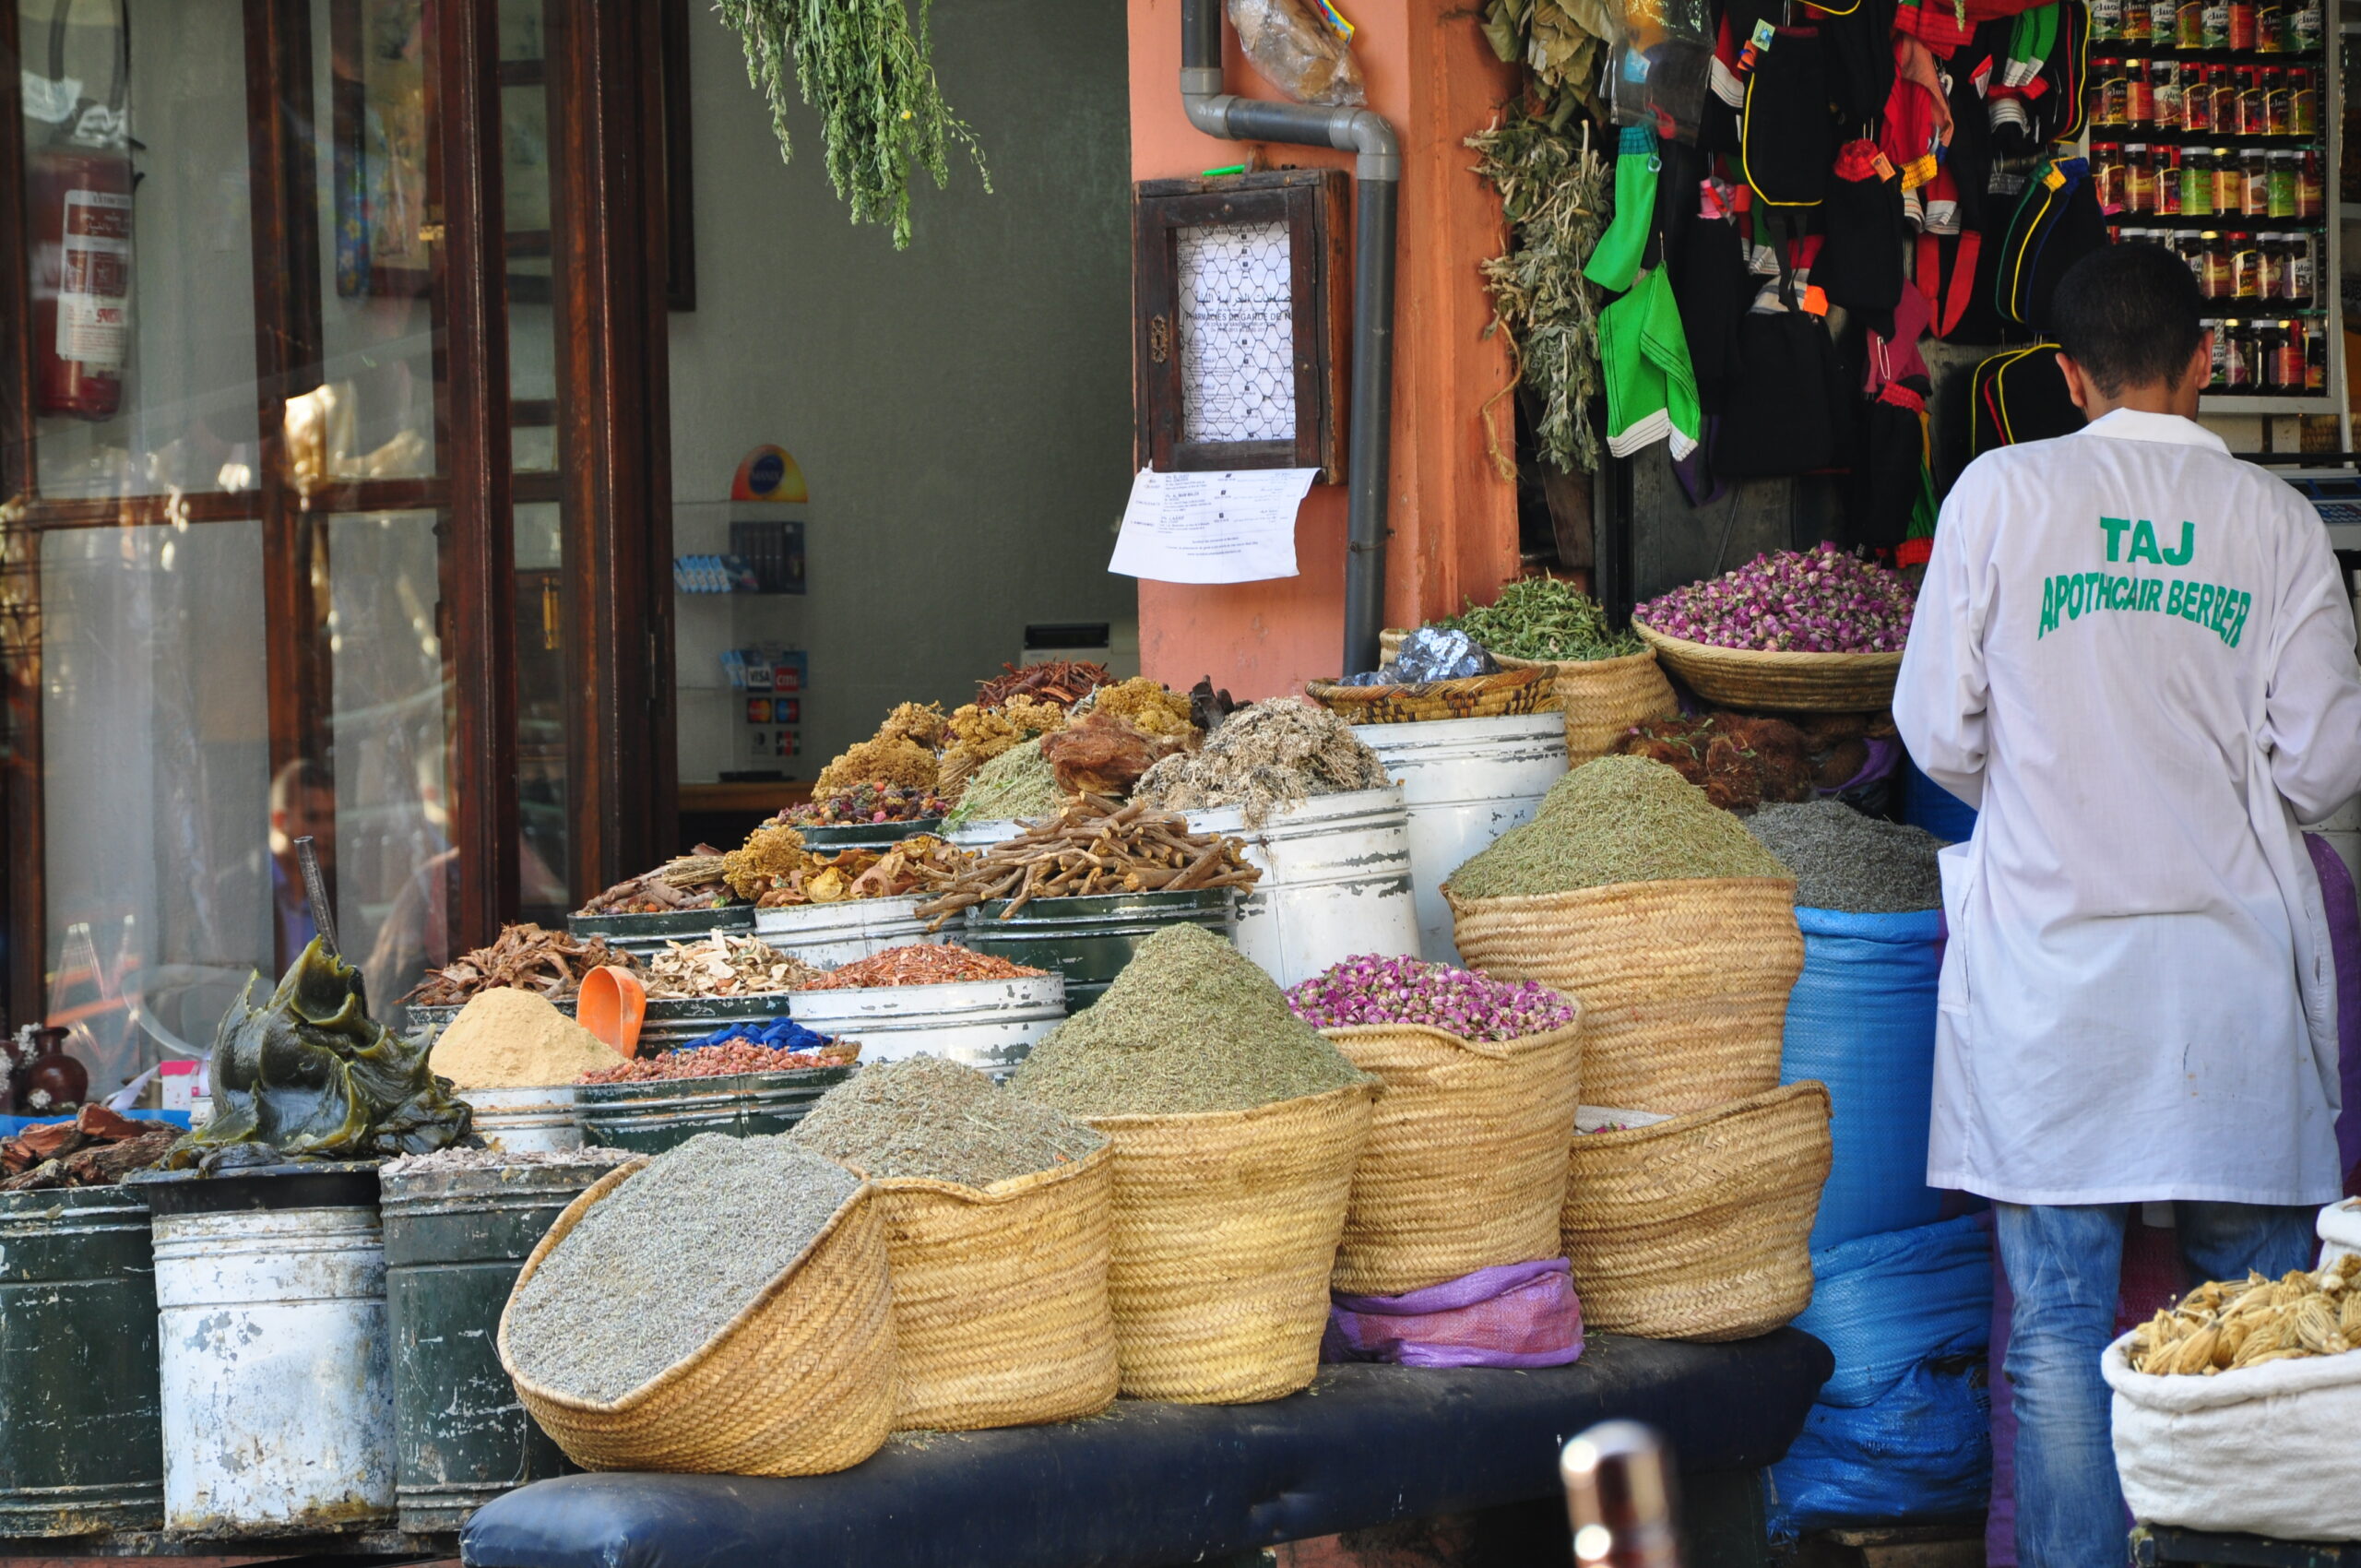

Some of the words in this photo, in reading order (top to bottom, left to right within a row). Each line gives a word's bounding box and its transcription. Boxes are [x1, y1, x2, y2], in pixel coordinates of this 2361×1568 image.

[2100, 516, 2195, 566] TAJ
[2037, 572, 2164, 641] APOTHCAIR
[2165, 579, 2252, 648] BERBER
[749, 670, 771, 683] VISA
